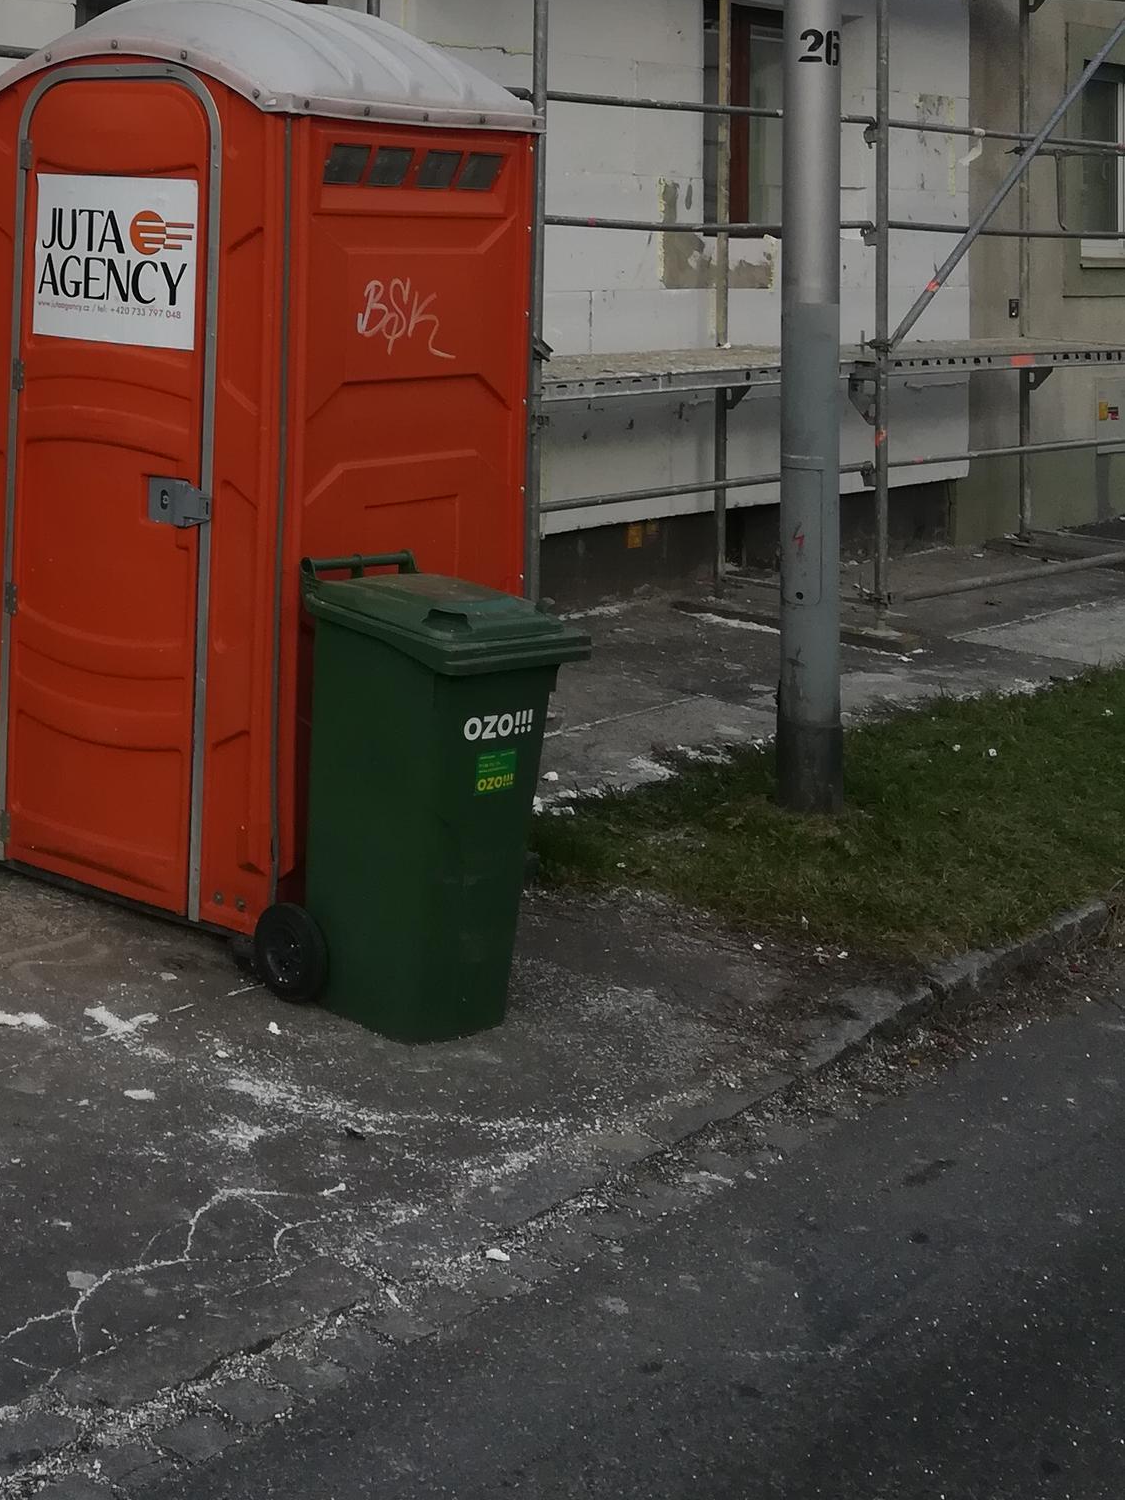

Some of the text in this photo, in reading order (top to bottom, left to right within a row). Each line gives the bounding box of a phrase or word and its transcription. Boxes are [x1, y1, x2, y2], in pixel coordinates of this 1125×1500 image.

[797, 28, 841, 67] 26
[41, 207, 126, 254] JUTA
[37, 252, 188, 306] AGENCY
[463, 708, 534, 741] OZO!!!
[477, 773, 515, 792] OZO!!!
